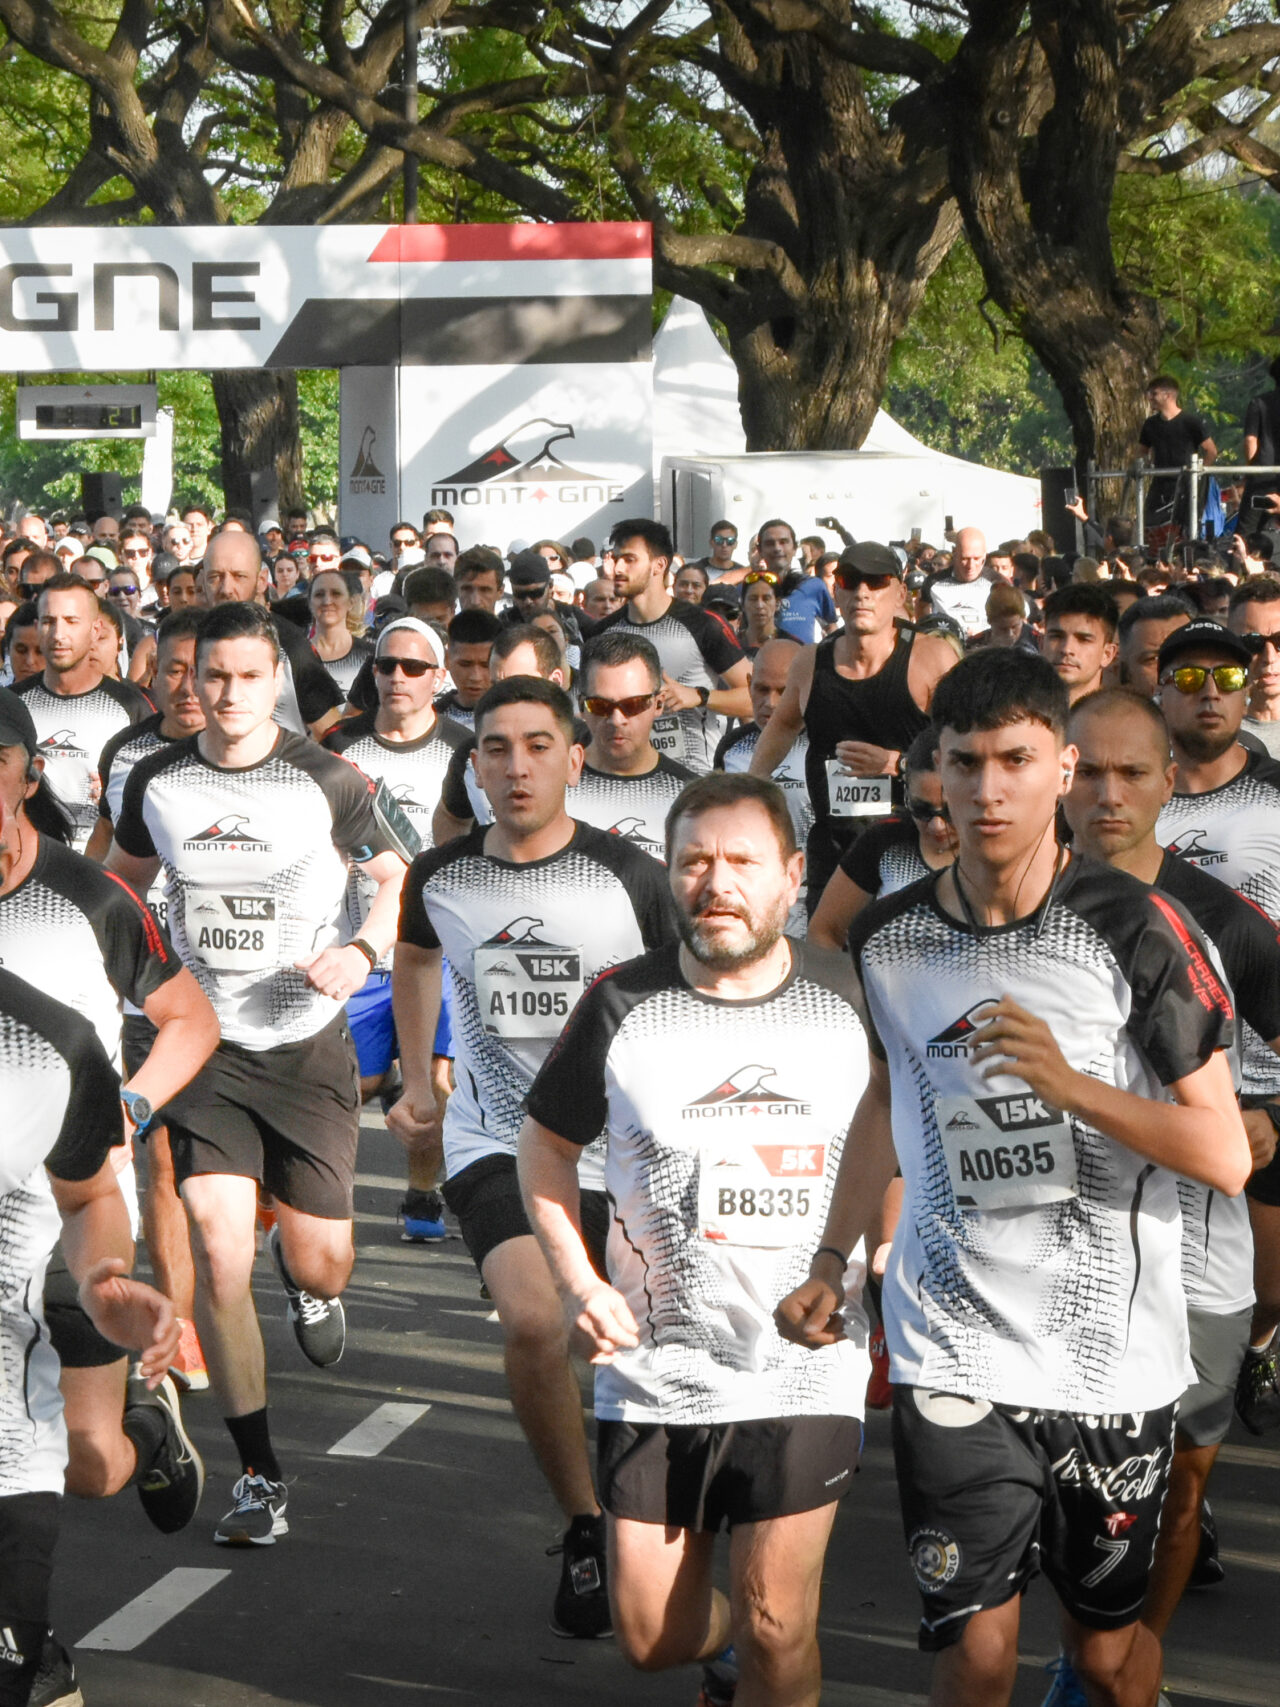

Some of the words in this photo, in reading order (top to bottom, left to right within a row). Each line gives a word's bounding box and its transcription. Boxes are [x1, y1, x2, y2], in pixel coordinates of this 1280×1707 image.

[431, 485, 624, 506] MONTAGNE
[1184, 622, 1223, 632] Jeep
[654, 720, 674, 731] 15K
[652, 736, 676, 750] 069
[835, 786, 881, 802] A2073
[232, 898, 267, 916] 15K
[198, 926, 265, 951] A0628
[530, 959, 570, 976] 15K
[490, 990, 569, 1016] A1095
[681, 1103, 812, 1120] MONTAGNE
[995, 1098, 1050, 1125] 15K
[780, 1150, 817, 1171] 5K
[959, 1141, 1055, 1182] A0635
[717, 1187, 811, 1218] B8335
[1080, 1535, 1130, 1588] 7
